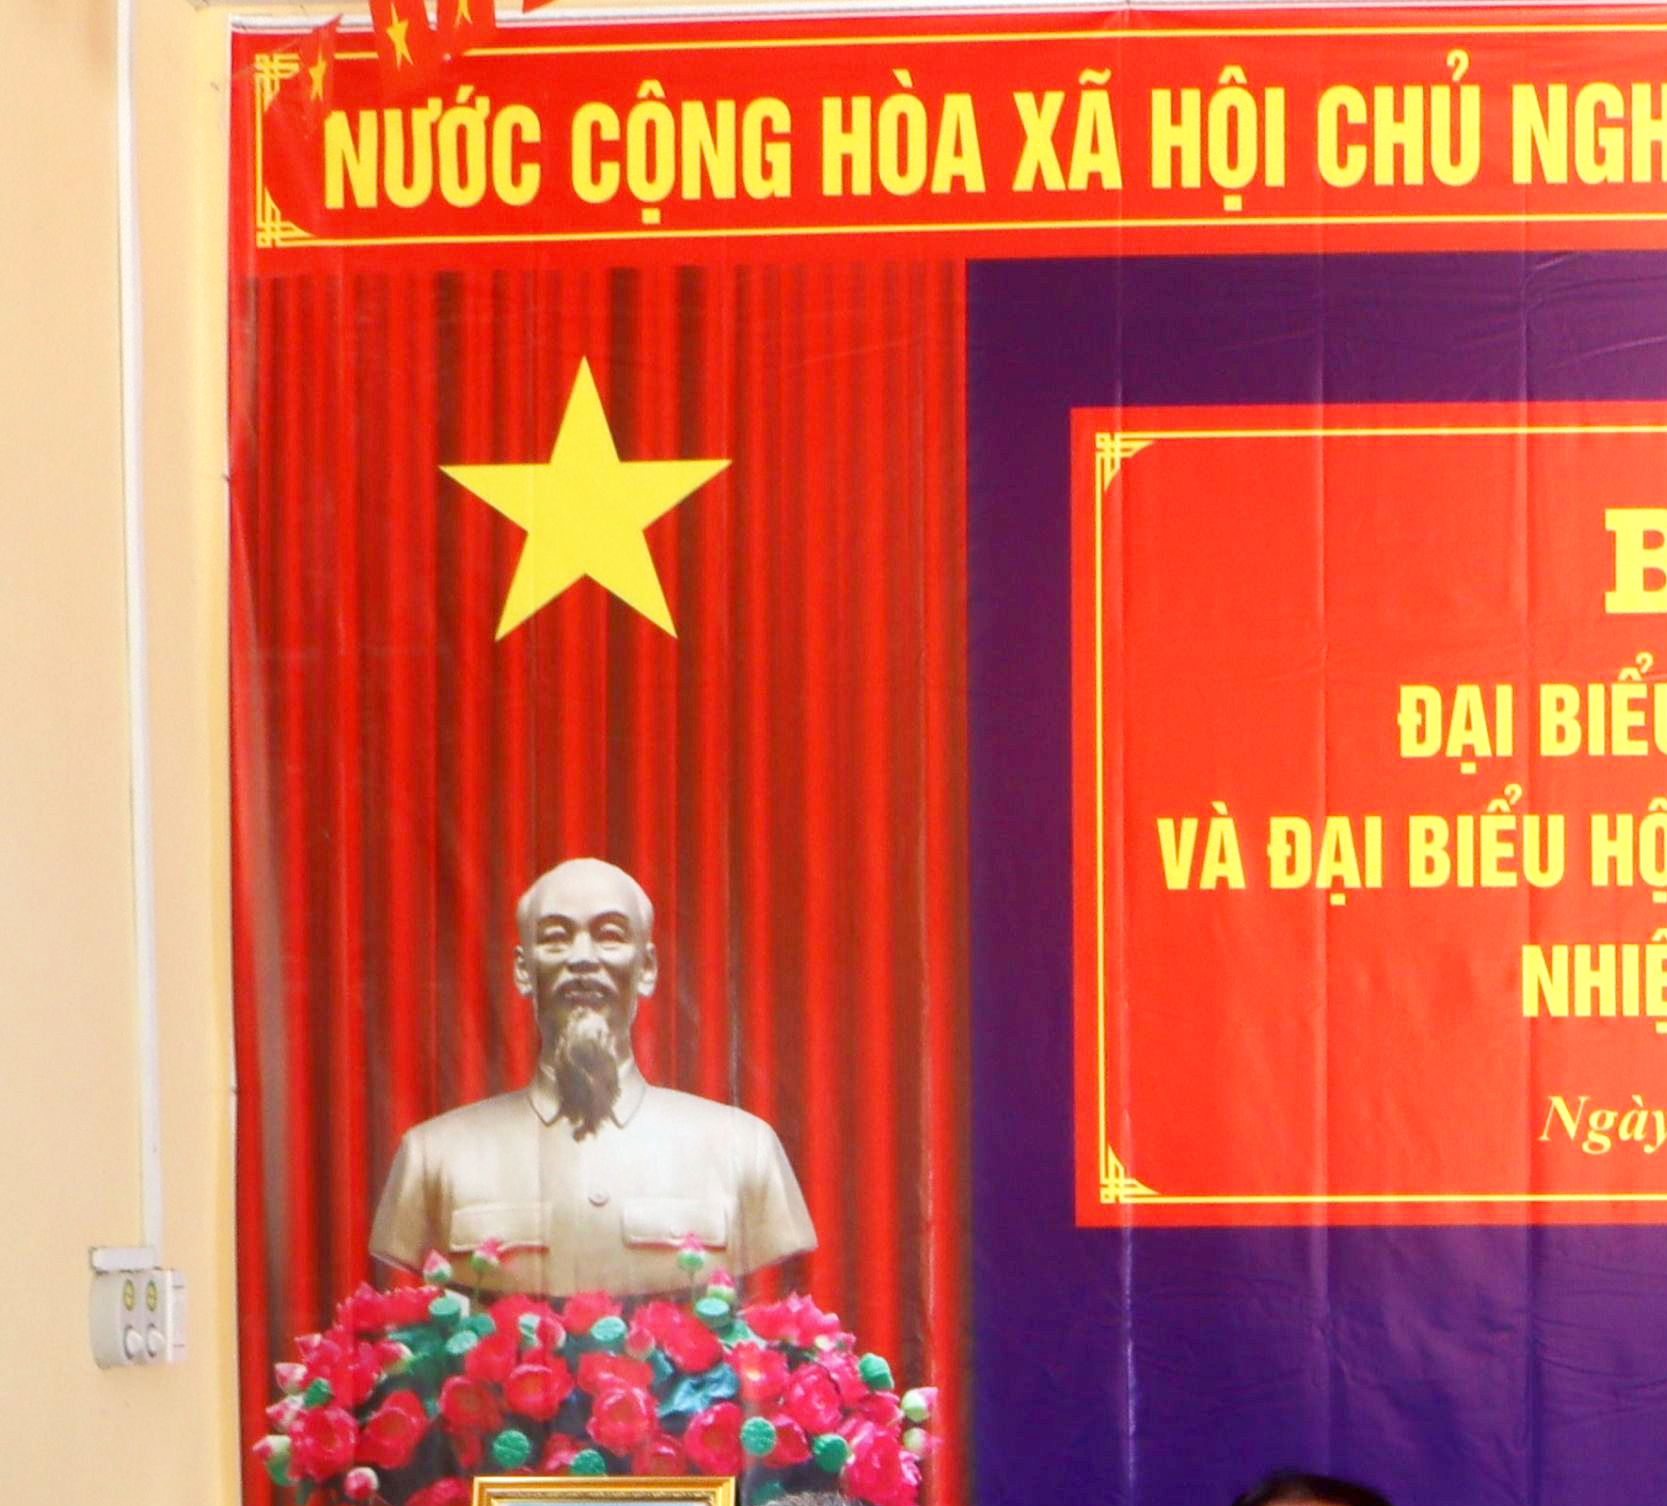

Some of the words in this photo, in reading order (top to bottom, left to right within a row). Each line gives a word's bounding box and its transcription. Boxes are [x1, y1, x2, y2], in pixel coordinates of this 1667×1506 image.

[325, 90, 540, 208] NƯỚC
[572, 80, 791, 224] CỘNG
[822, 70, 985, 196] HÒA
[1013, 69, 1122, 191] XÃ
[1152, 65, 1285, 211] HỘI
[1317, 49, 1481, 187] CHỦ
[1397, 684, 1514, 774] ĐẠI
[1157, 801, 1246, 890] VÀ
[1267, 816, 1383, 905] ĐẠI
[1409, 783, 1567, 888] BIỂU
